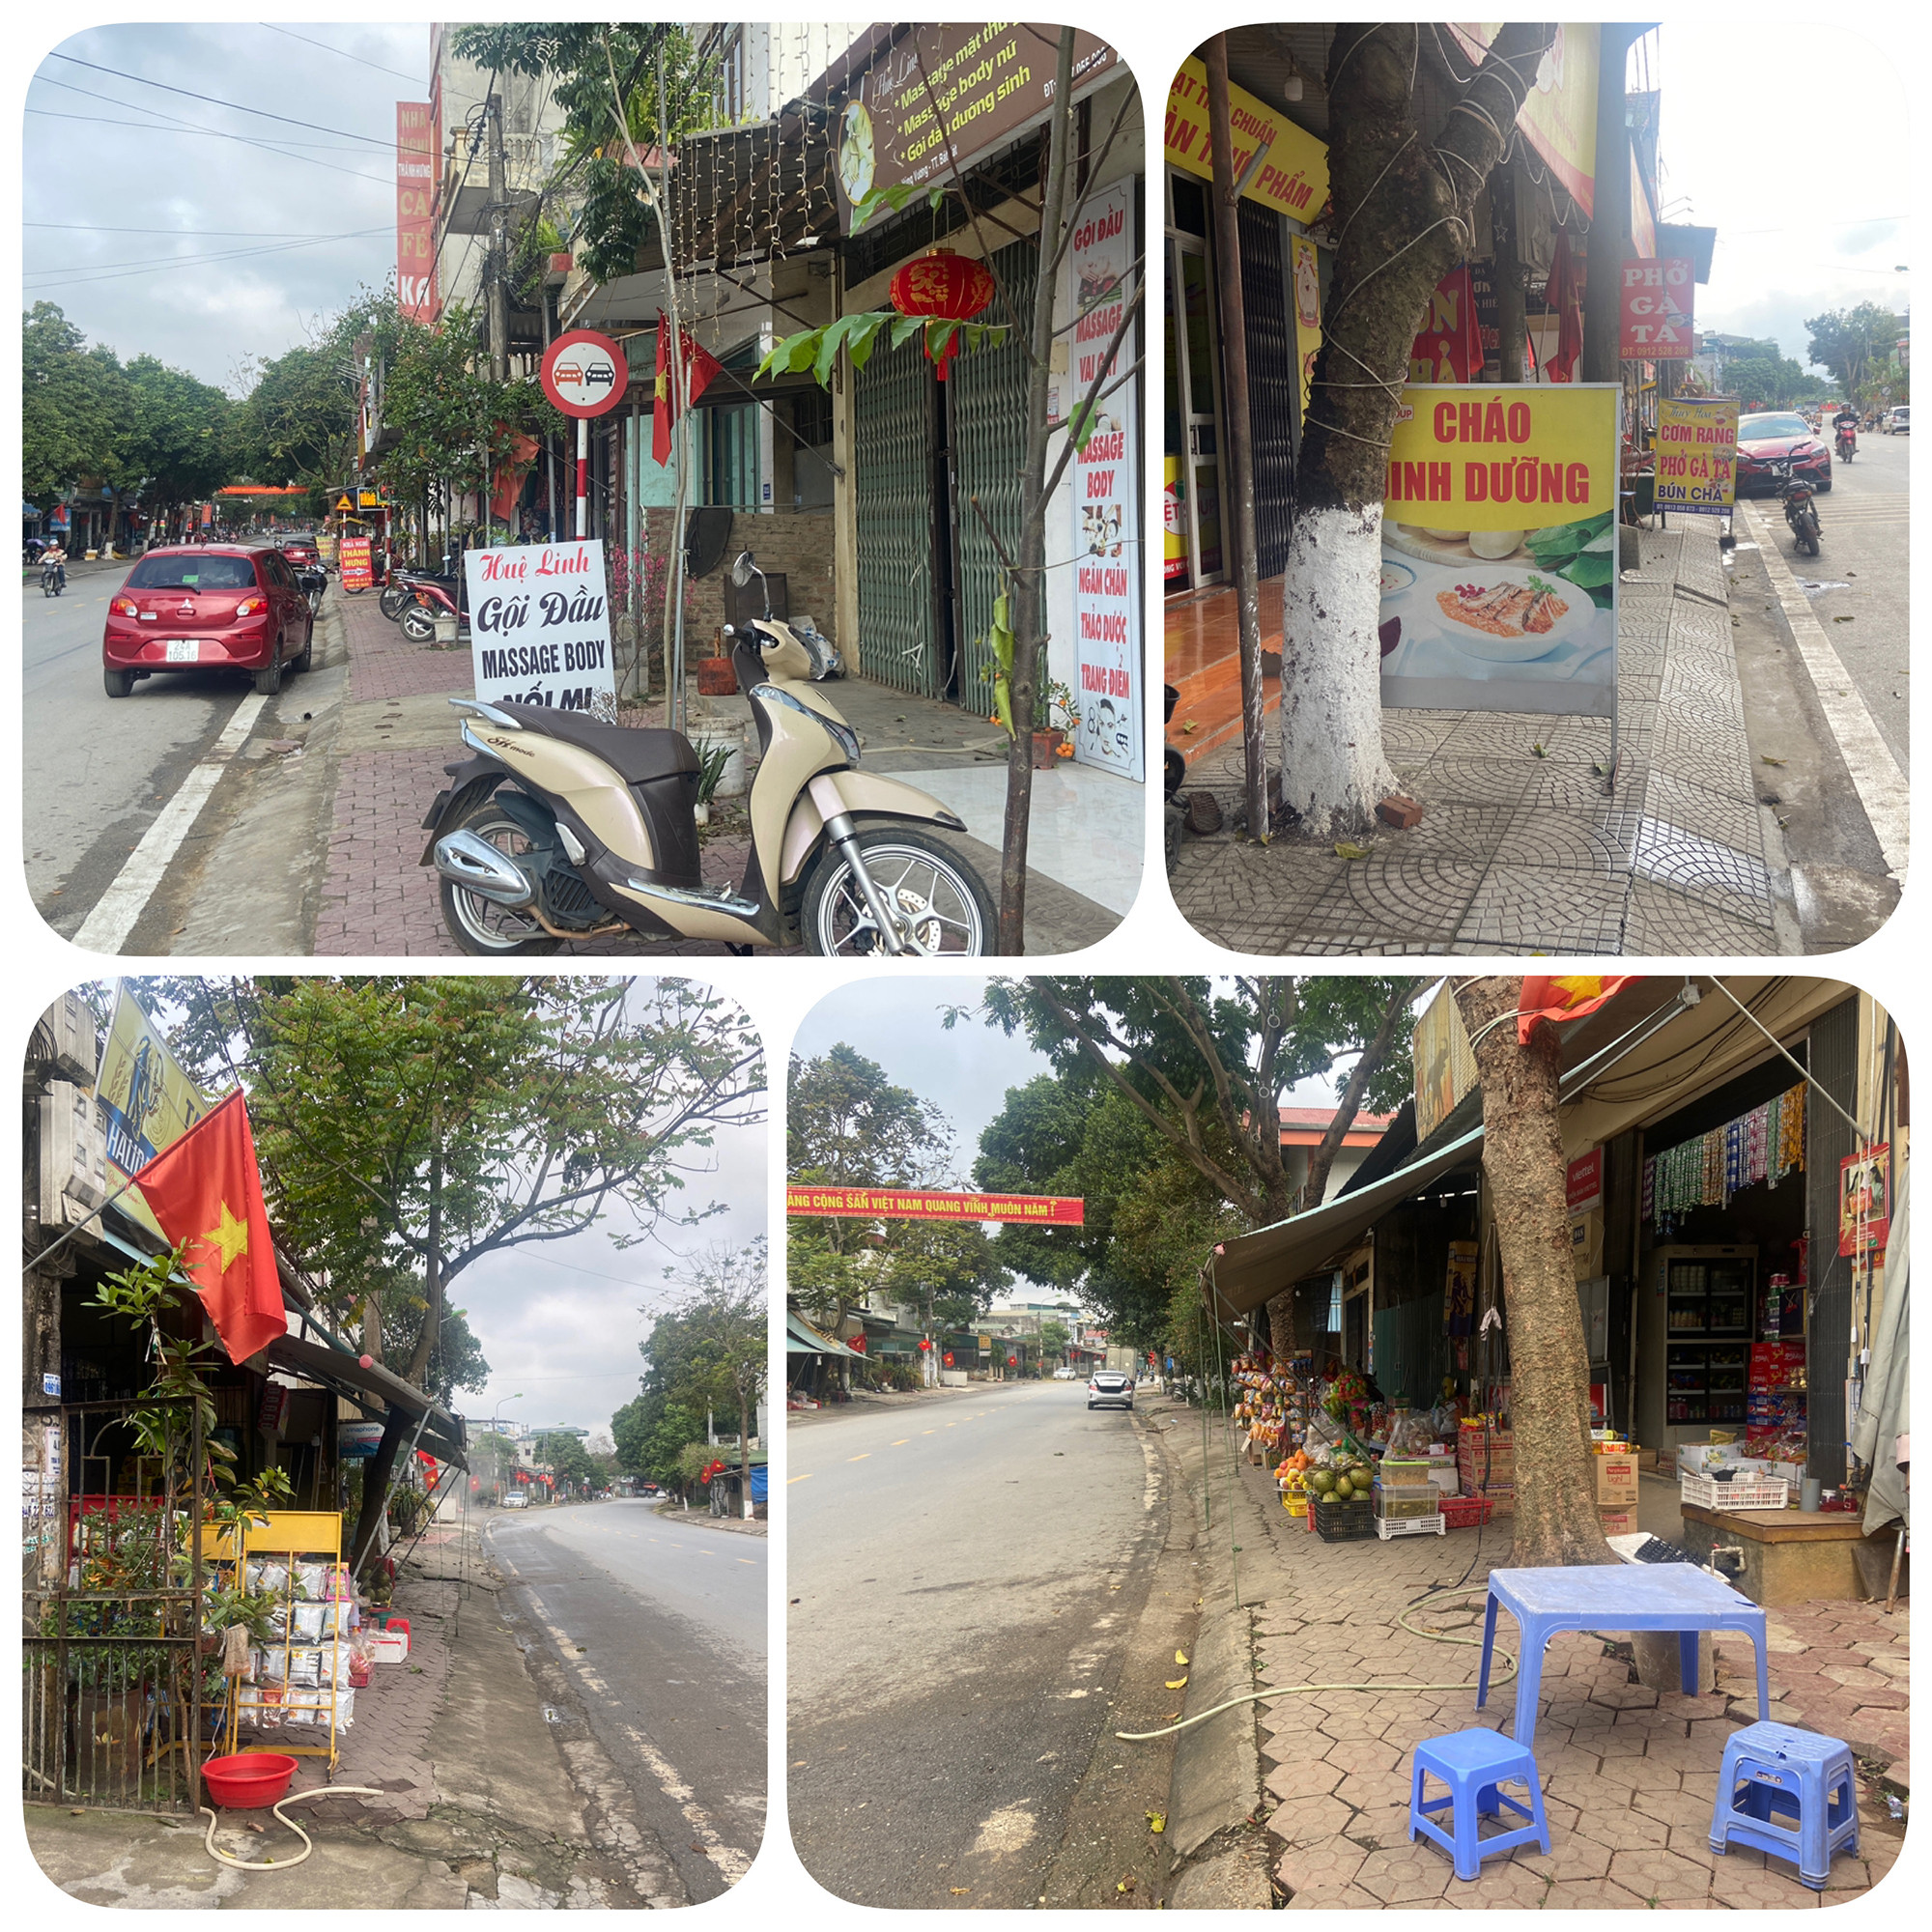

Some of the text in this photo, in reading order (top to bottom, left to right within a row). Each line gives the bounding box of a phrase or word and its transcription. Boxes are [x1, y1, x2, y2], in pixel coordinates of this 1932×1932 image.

[958, 56, 994, 96] body
[997, 65, 1032, 100] sinh
[401, 107, 426, 128] NHÀ
[1231, 107, 1278, 147] CHUẨN
[1255, 170, 1315, 211] PHẨM
[1074, 204, 1124, 255] GỘI ĐẦU
[1624, 259, 1689, 287] PHỞ
[1630, 291, 1682, 316] GÀ
[1076, 303, 1122, 344] MASSAGE
[1630, 324, 1680, 344] TA
[1079, 355, 1095, 384] VAI
[1434, 396, 1531, 444] CHÁO
[1662, 424, 1734, 444] CƠM RANG
[1384, 456, 1590, 505] INH DƯỠNG
[1660, 448, 1731, 479] PHỞ GÀ TA
[1087, 469, 1115, 498] BODY
[1658, 481, 1723, 501] BÚN CHẢ
[342, 548, 370, 558] THÀNH
[479, 547, 591, 583] Huệ Linh
[1079, 560, 1103, 595] NGÂM
[1104, 561, 1127, 597] CHÂN
[477, 584, 606, 638] Gội Đầu
[1081, 603, 1127, 652] THẢO DƯỢC
[168, 650, 196, 661] 105.16
[482, 639, 606, 679] MASSAGE BODY
[1081, 654, 1130, 700] TRANG ĐIỂM
[1572, 1162, 1595, 1181] viettel
[812, 1193, 843, 1210] CỘNG
[871, 1195, 895, 1212] VIỆT
[896, 1198, 923, 1211] NAM
[925, 1199, 961, 1213] QUANG
[963, 1197, 987, 1213] VĨNH
[990, 1201, 1022, 1215] MUÔN
[1024, 1203, 1048, 1216] NĂM
